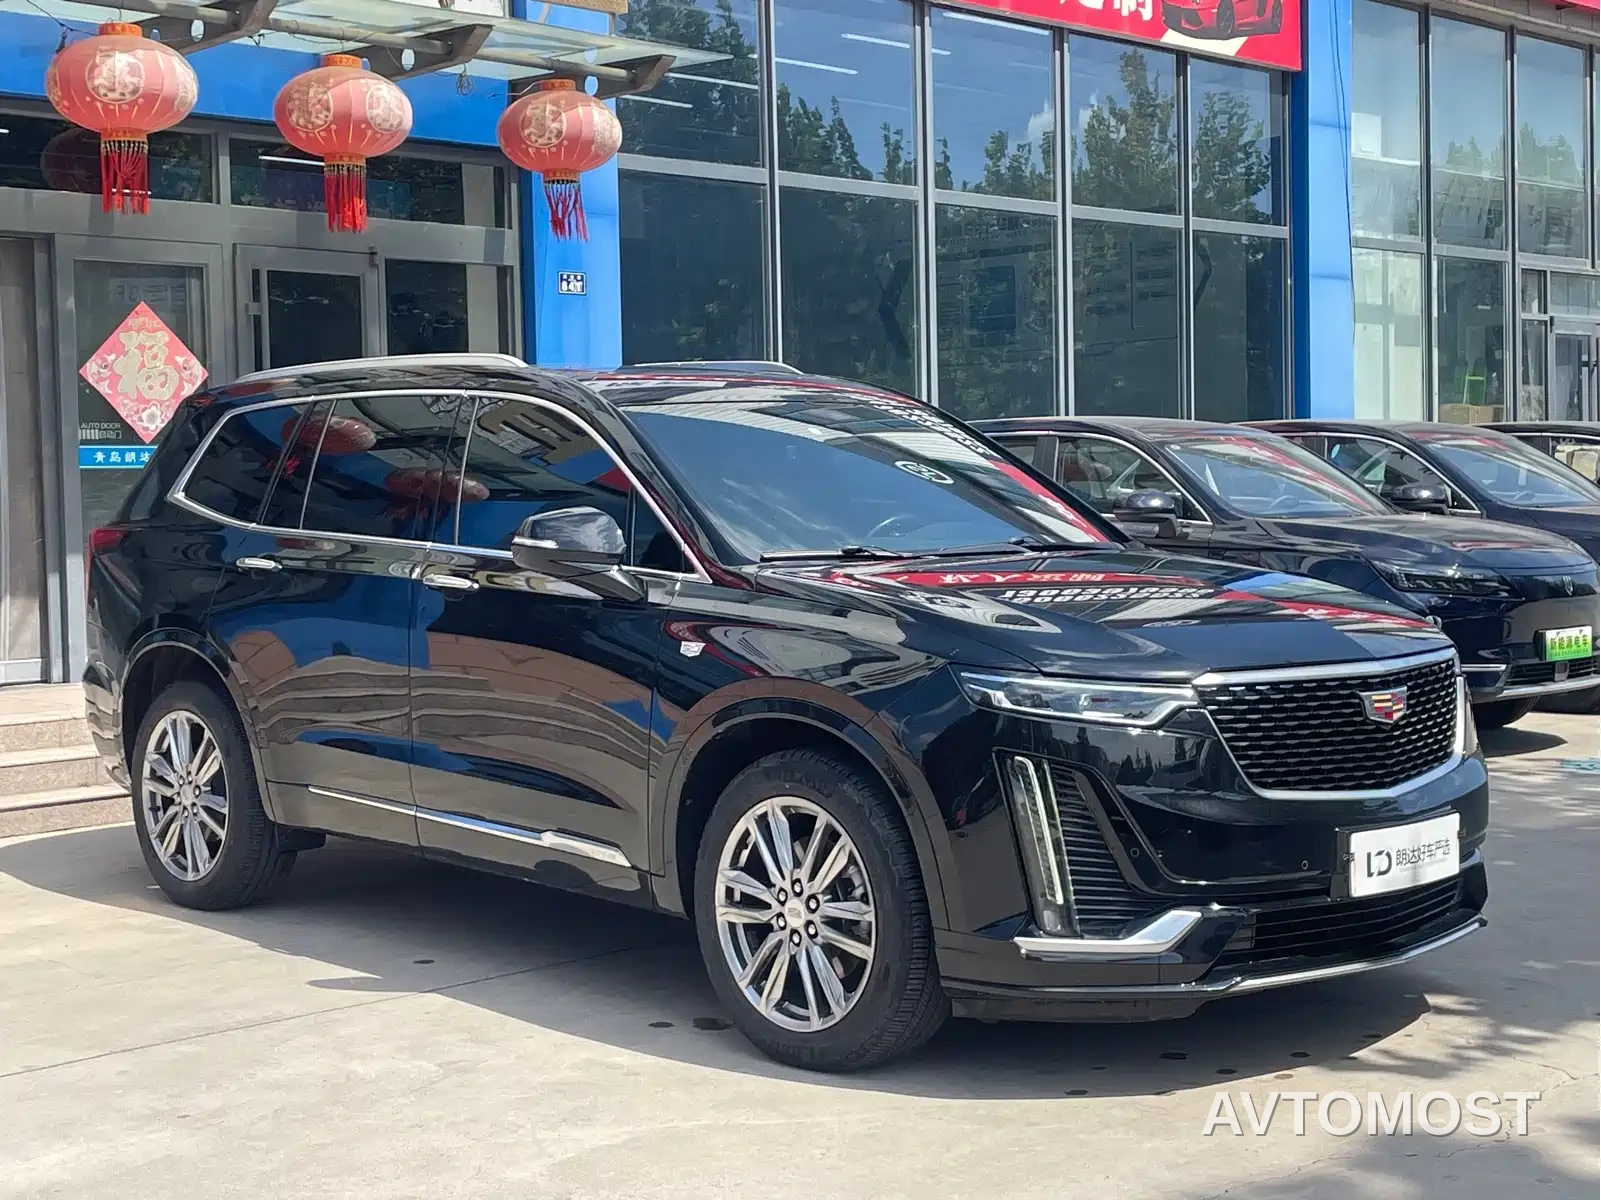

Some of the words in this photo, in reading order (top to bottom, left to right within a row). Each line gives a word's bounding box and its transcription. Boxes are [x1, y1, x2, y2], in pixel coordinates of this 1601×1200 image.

[112, 330, 180, 401] 福
[1549, 634, 1589, 650] 新能源电车
